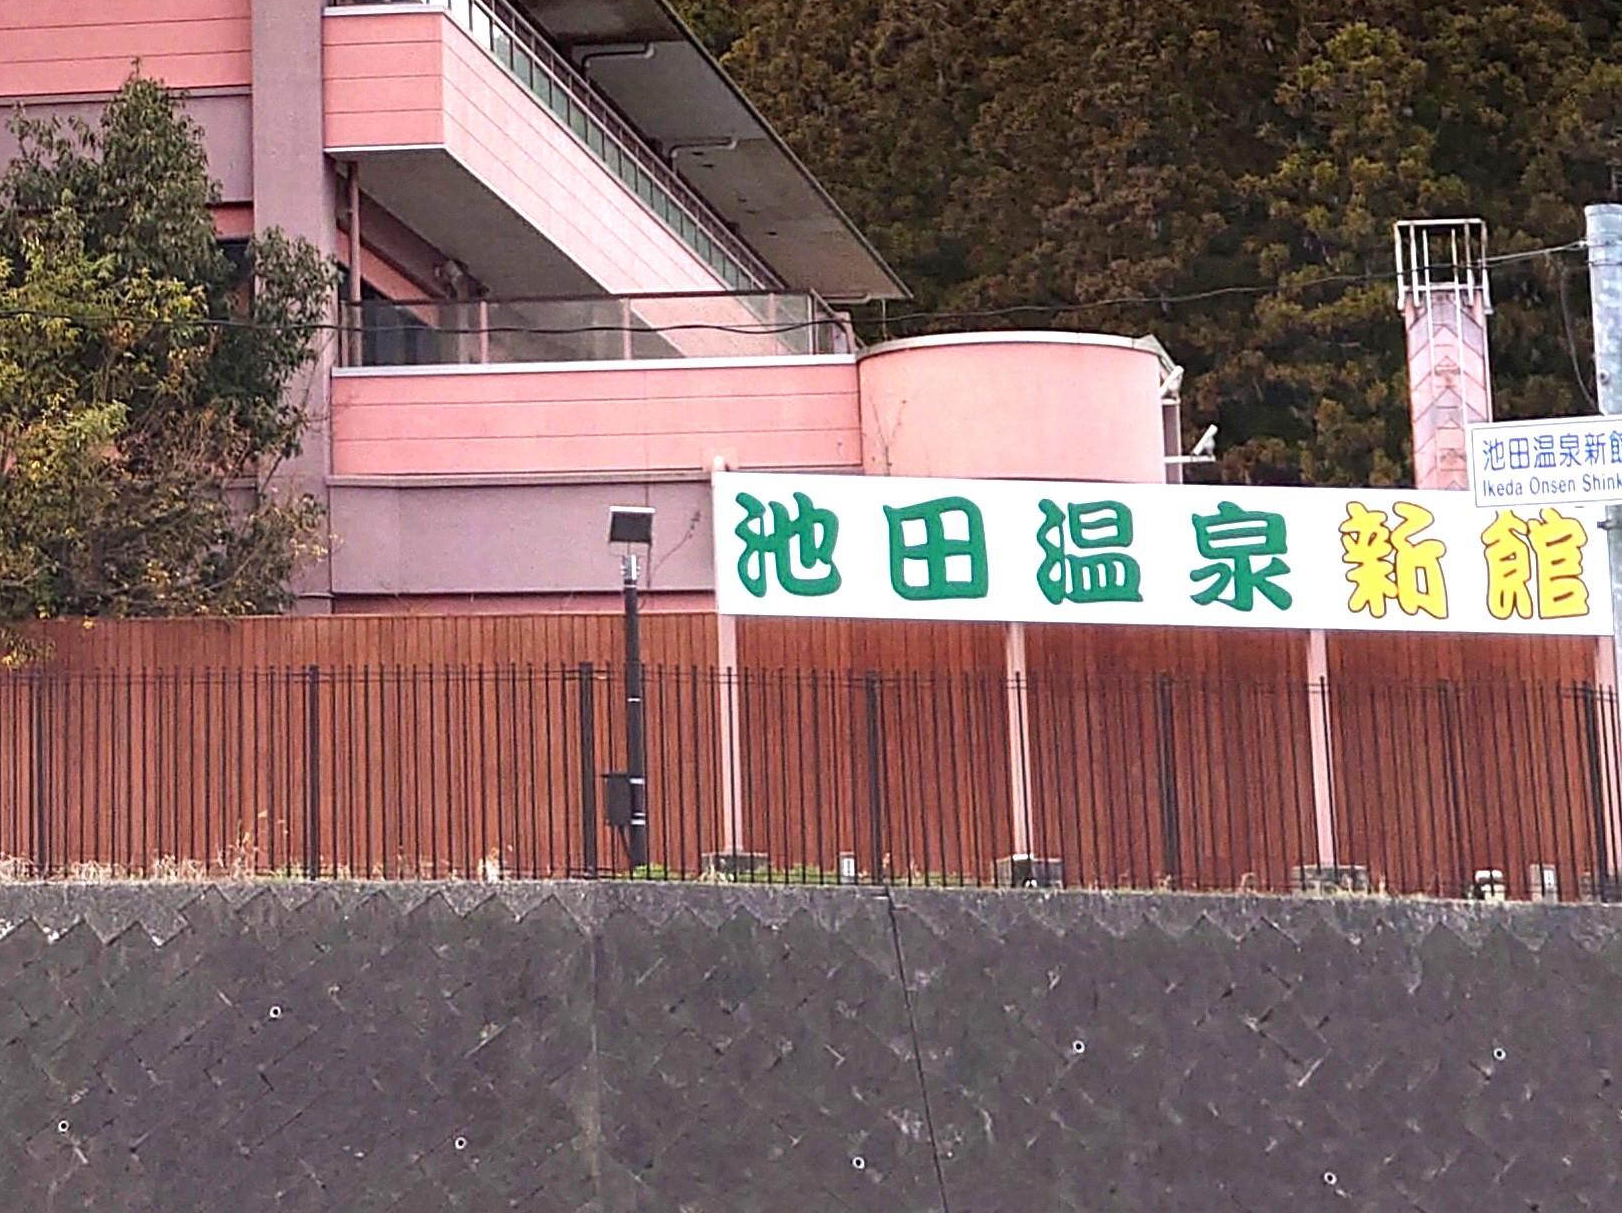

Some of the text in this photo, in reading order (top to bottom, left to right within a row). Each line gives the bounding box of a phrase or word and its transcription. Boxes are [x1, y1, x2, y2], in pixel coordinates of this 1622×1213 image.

[1483, 479, 1523, 497] Ikeda
[1529, 476, 1576, 495] Onsen
[734, 491, 1590, 620] 池田温泉新館
